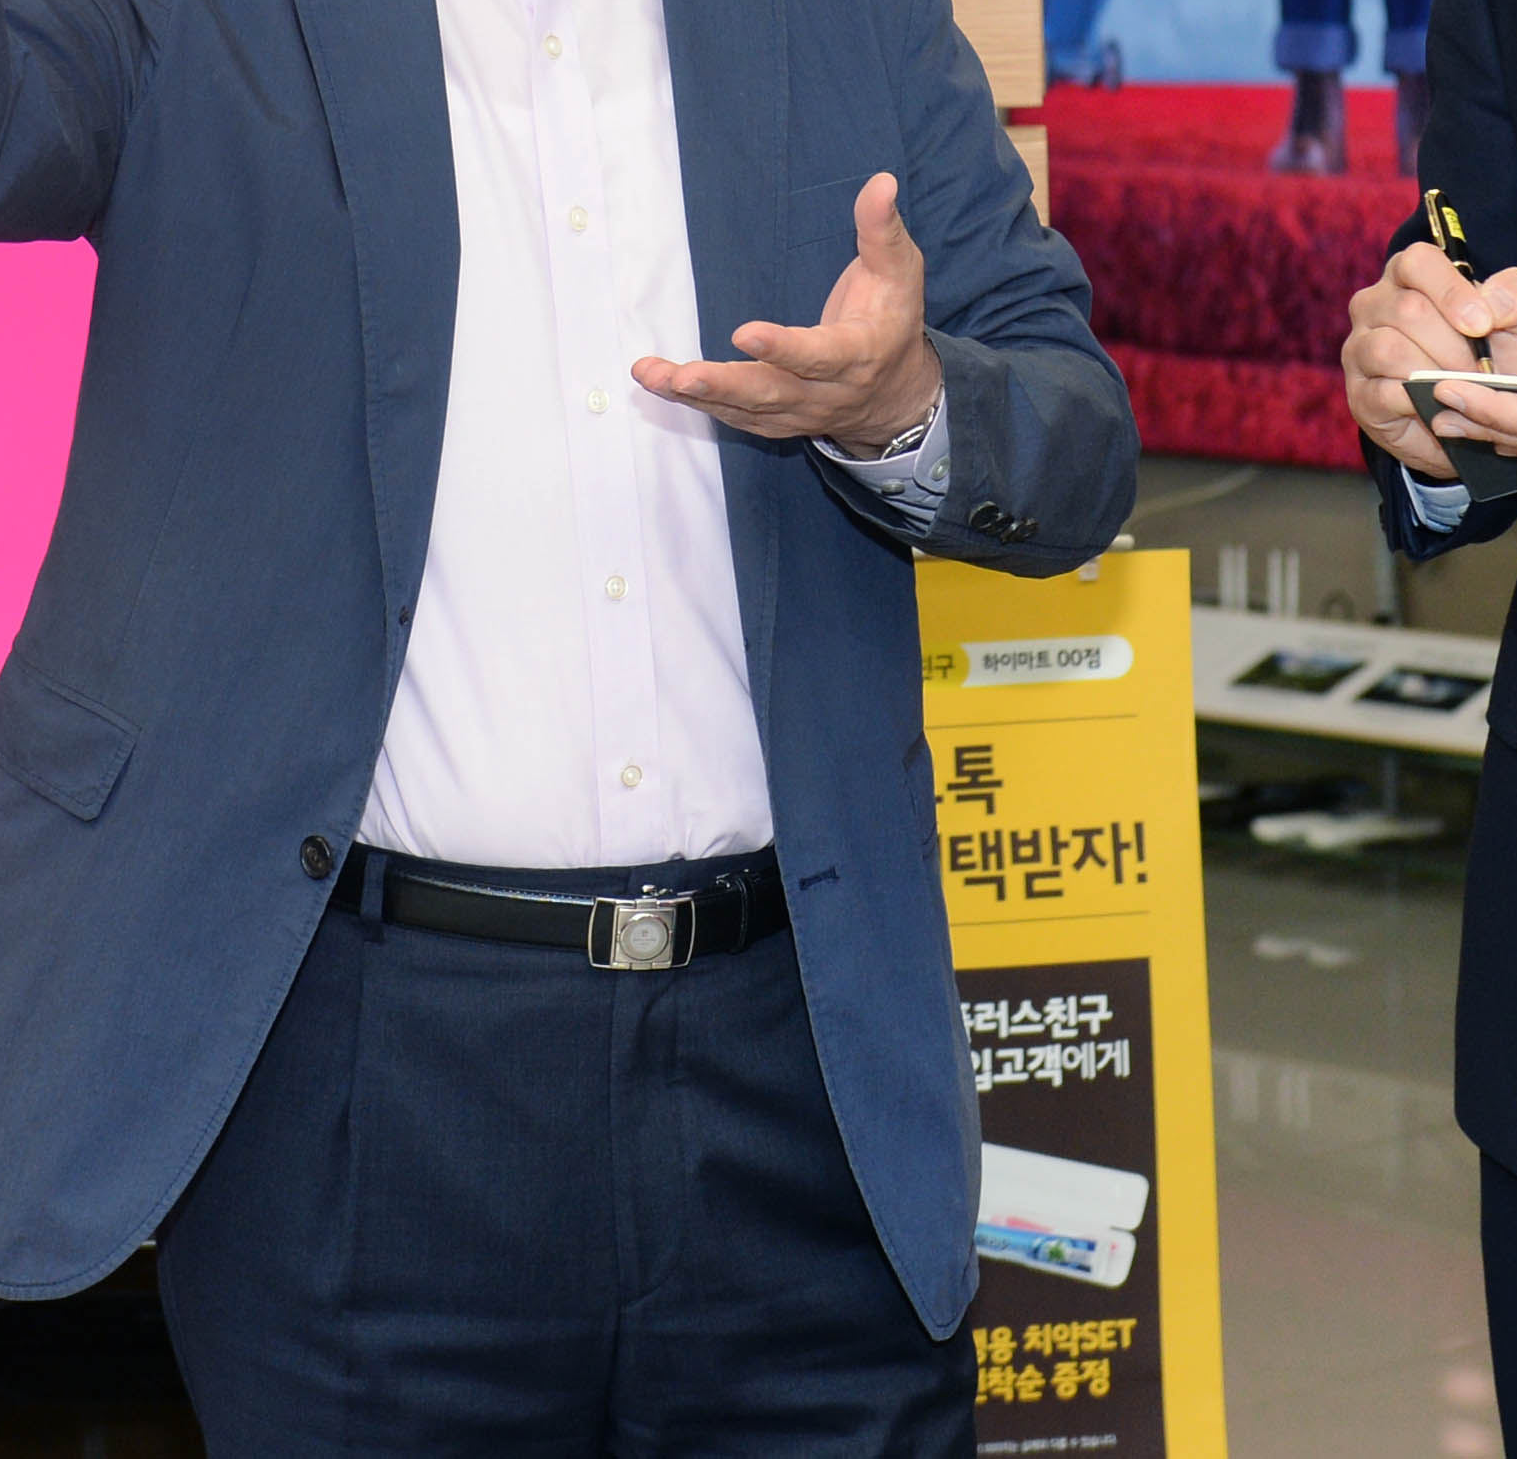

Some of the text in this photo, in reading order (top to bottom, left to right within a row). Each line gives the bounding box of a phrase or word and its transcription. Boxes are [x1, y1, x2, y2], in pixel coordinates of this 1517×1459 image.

[982, 649, 1051, 673] 하이마트
[935, 744, 1003, 815] 톡
[937, 822, 1147, 902] 택받자!
[1023, 1318, 1138, 1358] 치약SET
[1050, 1358, 1111, 1400] 증정
